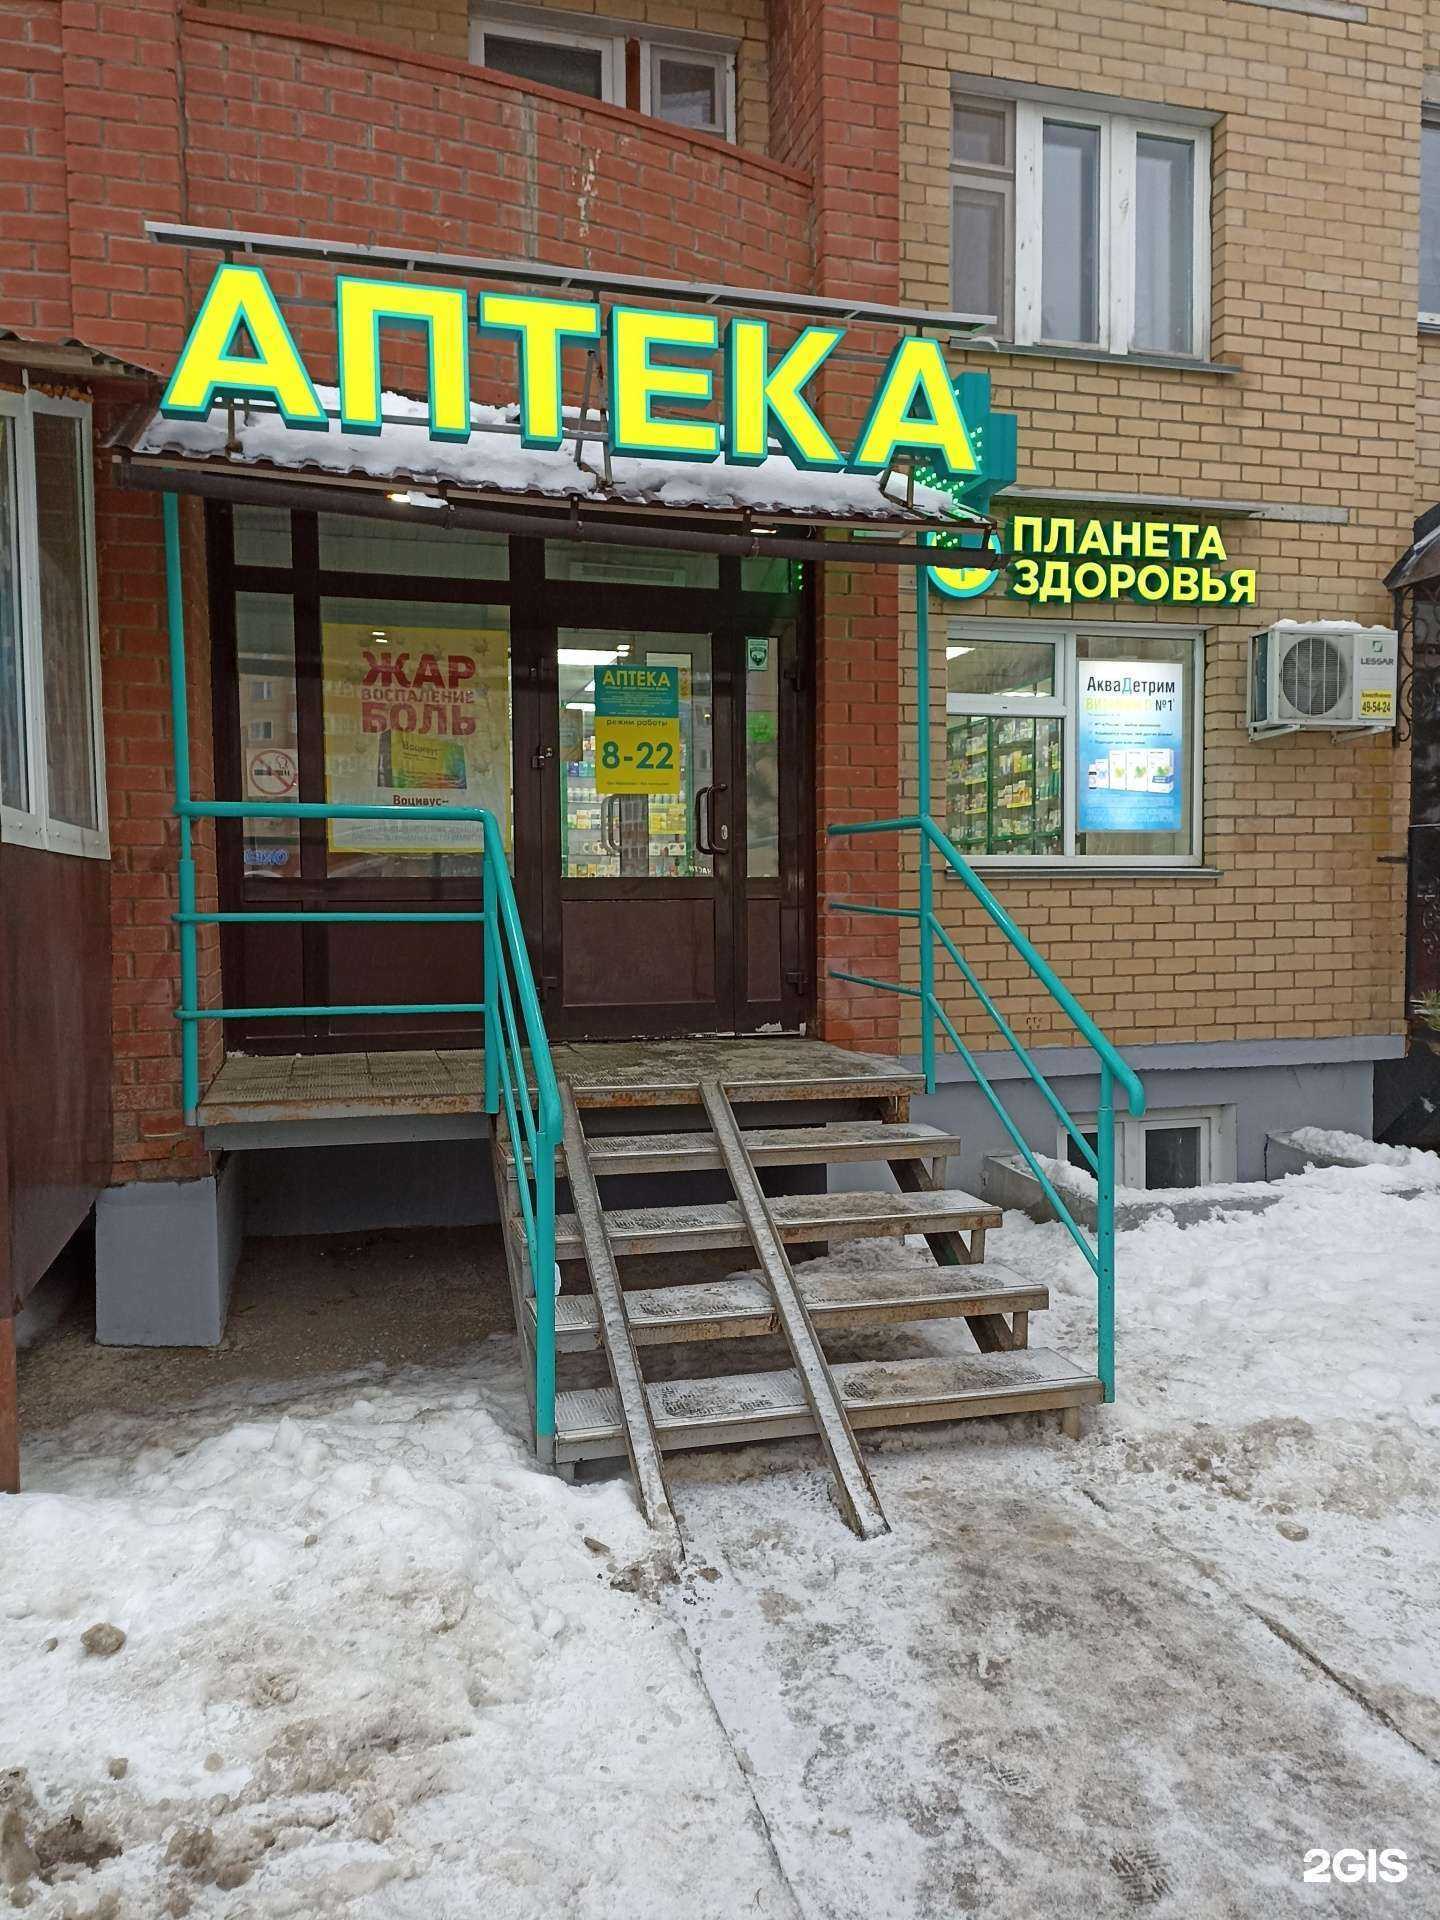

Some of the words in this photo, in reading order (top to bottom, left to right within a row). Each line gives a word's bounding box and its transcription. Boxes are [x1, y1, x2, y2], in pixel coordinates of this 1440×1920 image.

[161, 264, 982, 475] АПТЕКА
[1013, 515, 1227, 561] ПЛАНЕТА
[1013, 559, 1256, 603] ЗДОРОВЬЯ
[362, 651, 476, 689] ЖАР
[1360, 657, 1394, 665] LESSAR
[602, 670, 671, 687] АПТЕКА
[1086, 676, 1175, 696] АкваДетрим
[361, 688, 475, 704] ВОСПАЛЕНИЕ
[1362, 701, 1391, 713] 49-54-24
[361, 702, 477, 736] БОЛЬ
[606, 718, 634, 726] режим
[636, 718, 668, 727] работы
[602, 741, 674, 769] 8-22
